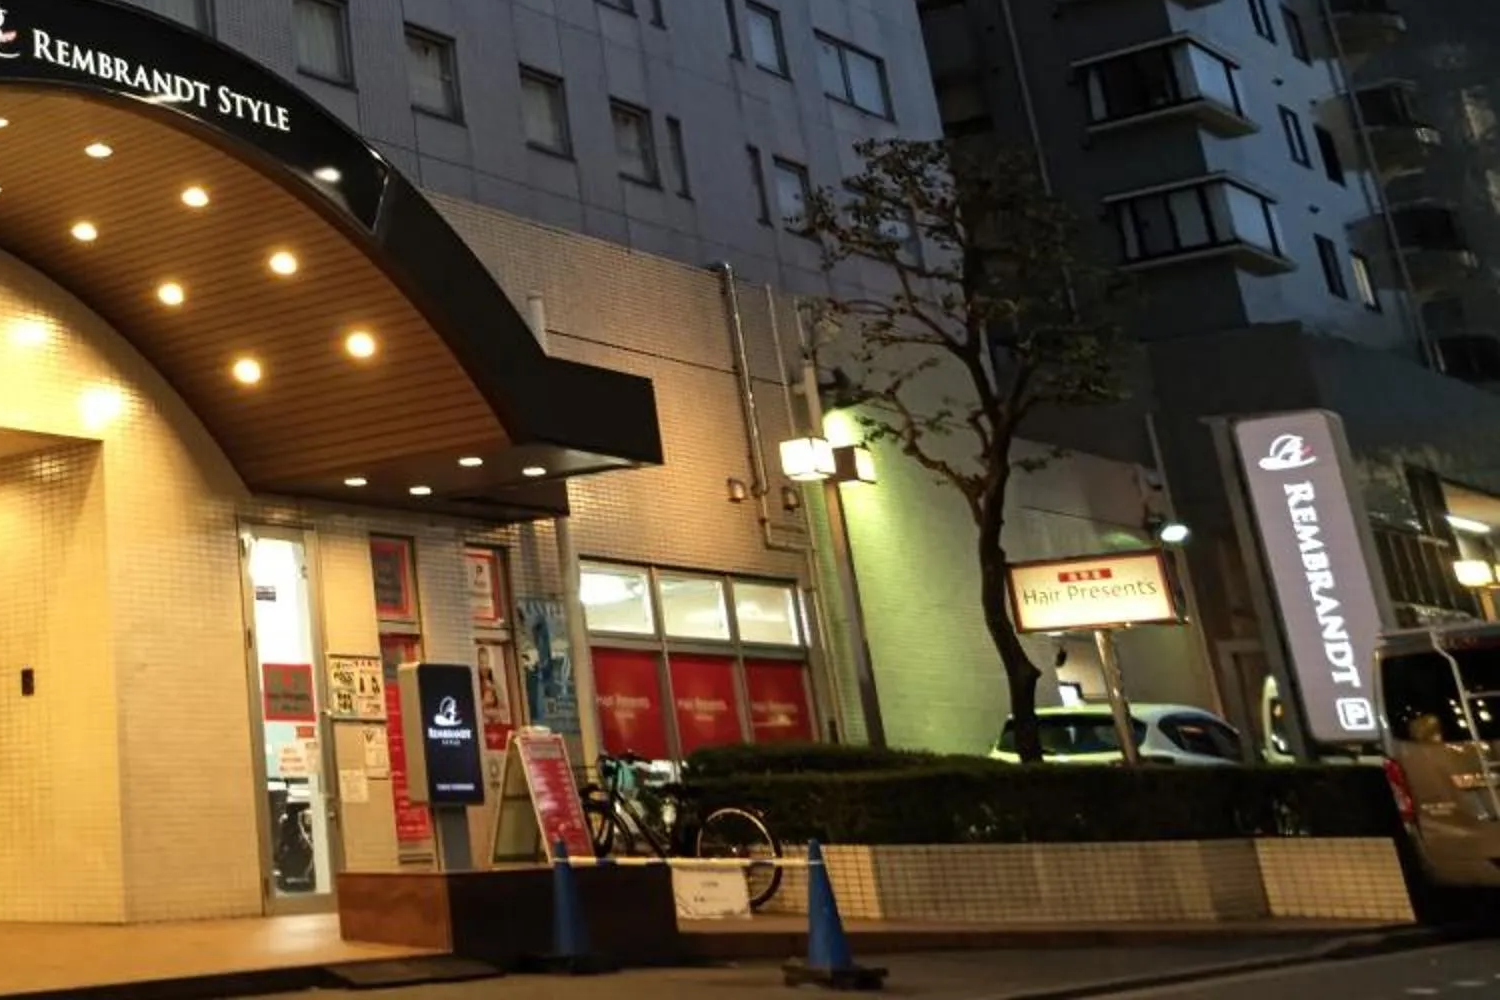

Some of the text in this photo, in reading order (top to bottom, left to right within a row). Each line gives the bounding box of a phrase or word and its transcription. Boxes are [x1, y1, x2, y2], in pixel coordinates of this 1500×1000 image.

[32, 28, 291, 131] REMBRANDT STYLE
[1022, 588, 1060, 605] Hair
[1283, 480, 1361, 688] REMBRANDT
